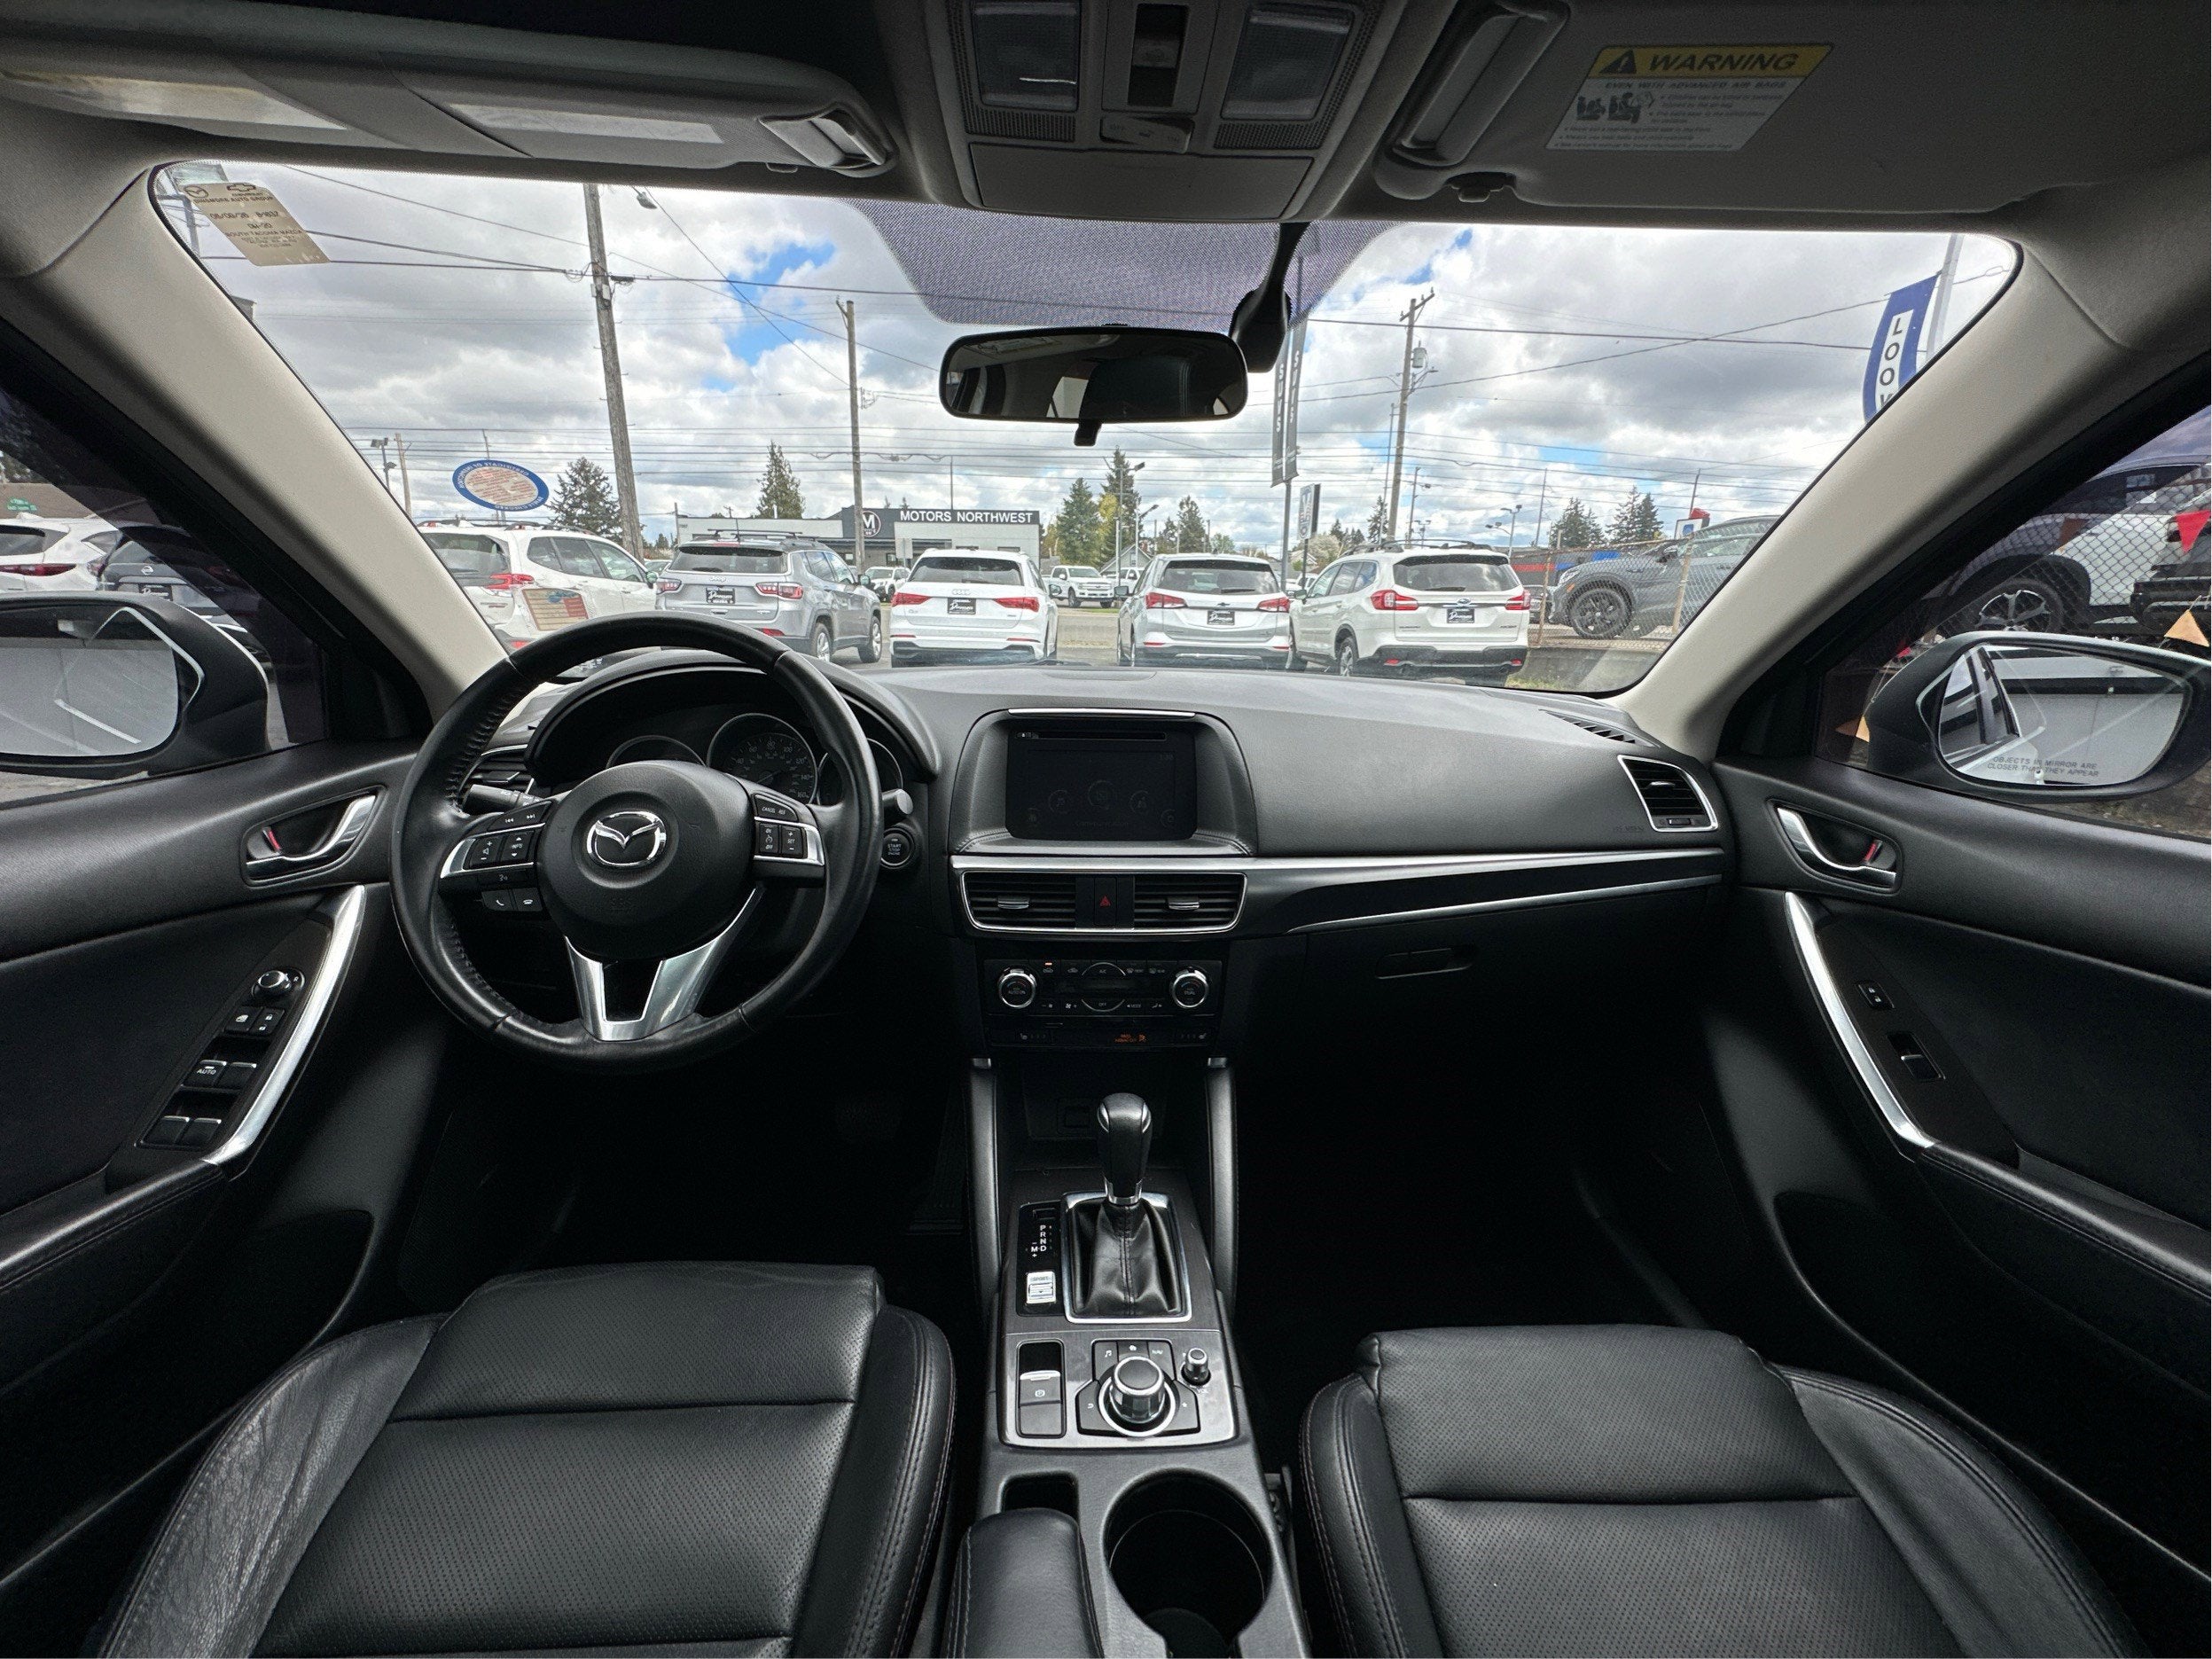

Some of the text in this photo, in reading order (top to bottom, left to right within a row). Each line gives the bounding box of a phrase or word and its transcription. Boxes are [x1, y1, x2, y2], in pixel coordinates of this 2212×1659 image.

[1649, 53, 1799, 71] WARNING
[900, 511, 1034, 524] MOTORS NORTHWEST
[1993, 755, 2030, 764] OBJECTS
[2044, 759, 2077, 768] MIRROR
